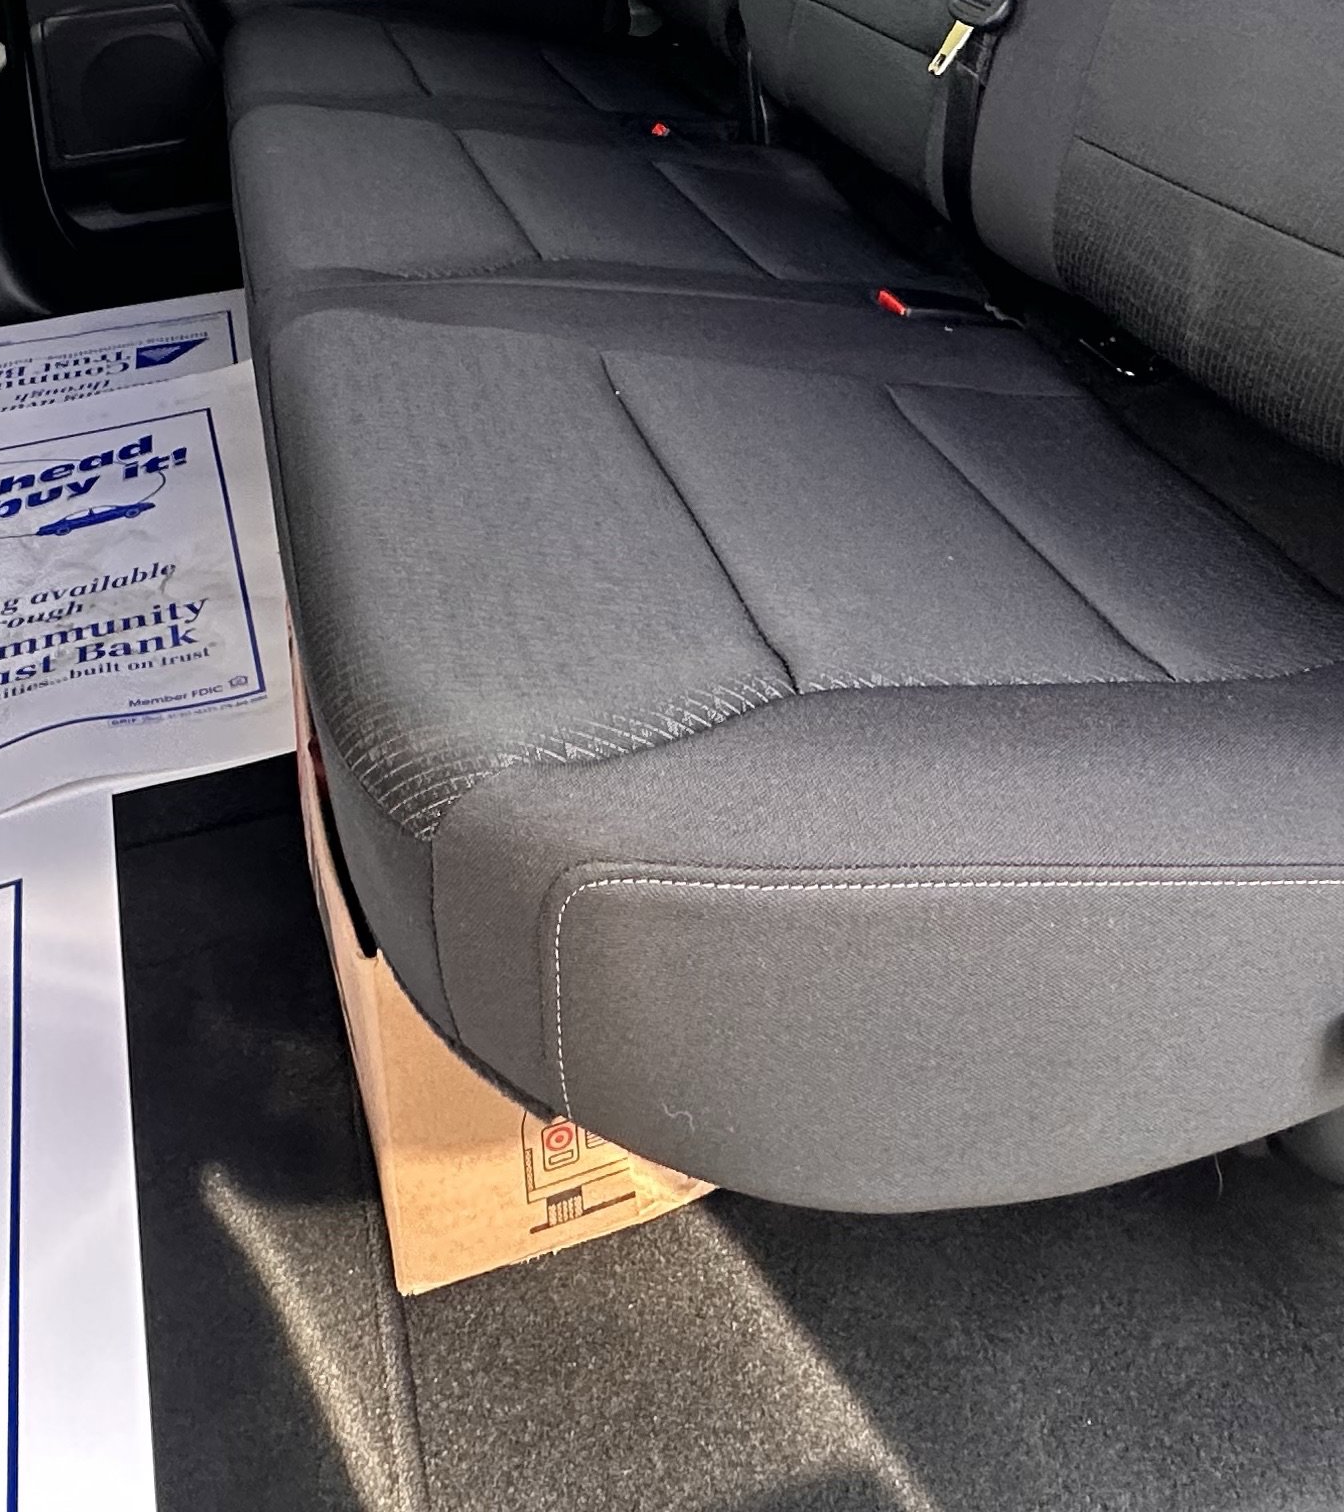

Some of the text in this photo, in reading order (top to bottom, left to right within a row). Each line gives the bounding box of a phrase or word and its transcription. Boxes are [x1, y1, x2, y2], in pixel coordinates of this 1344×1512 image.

[122, 446, 188, 483] it!
[30, 561, 177, 606] available
[75, 623, 200, 665] Bank
[126, 658, 155, 672] on
[128, 692, 188, 709] Member
[191, 684, 224, 699] FDIC
